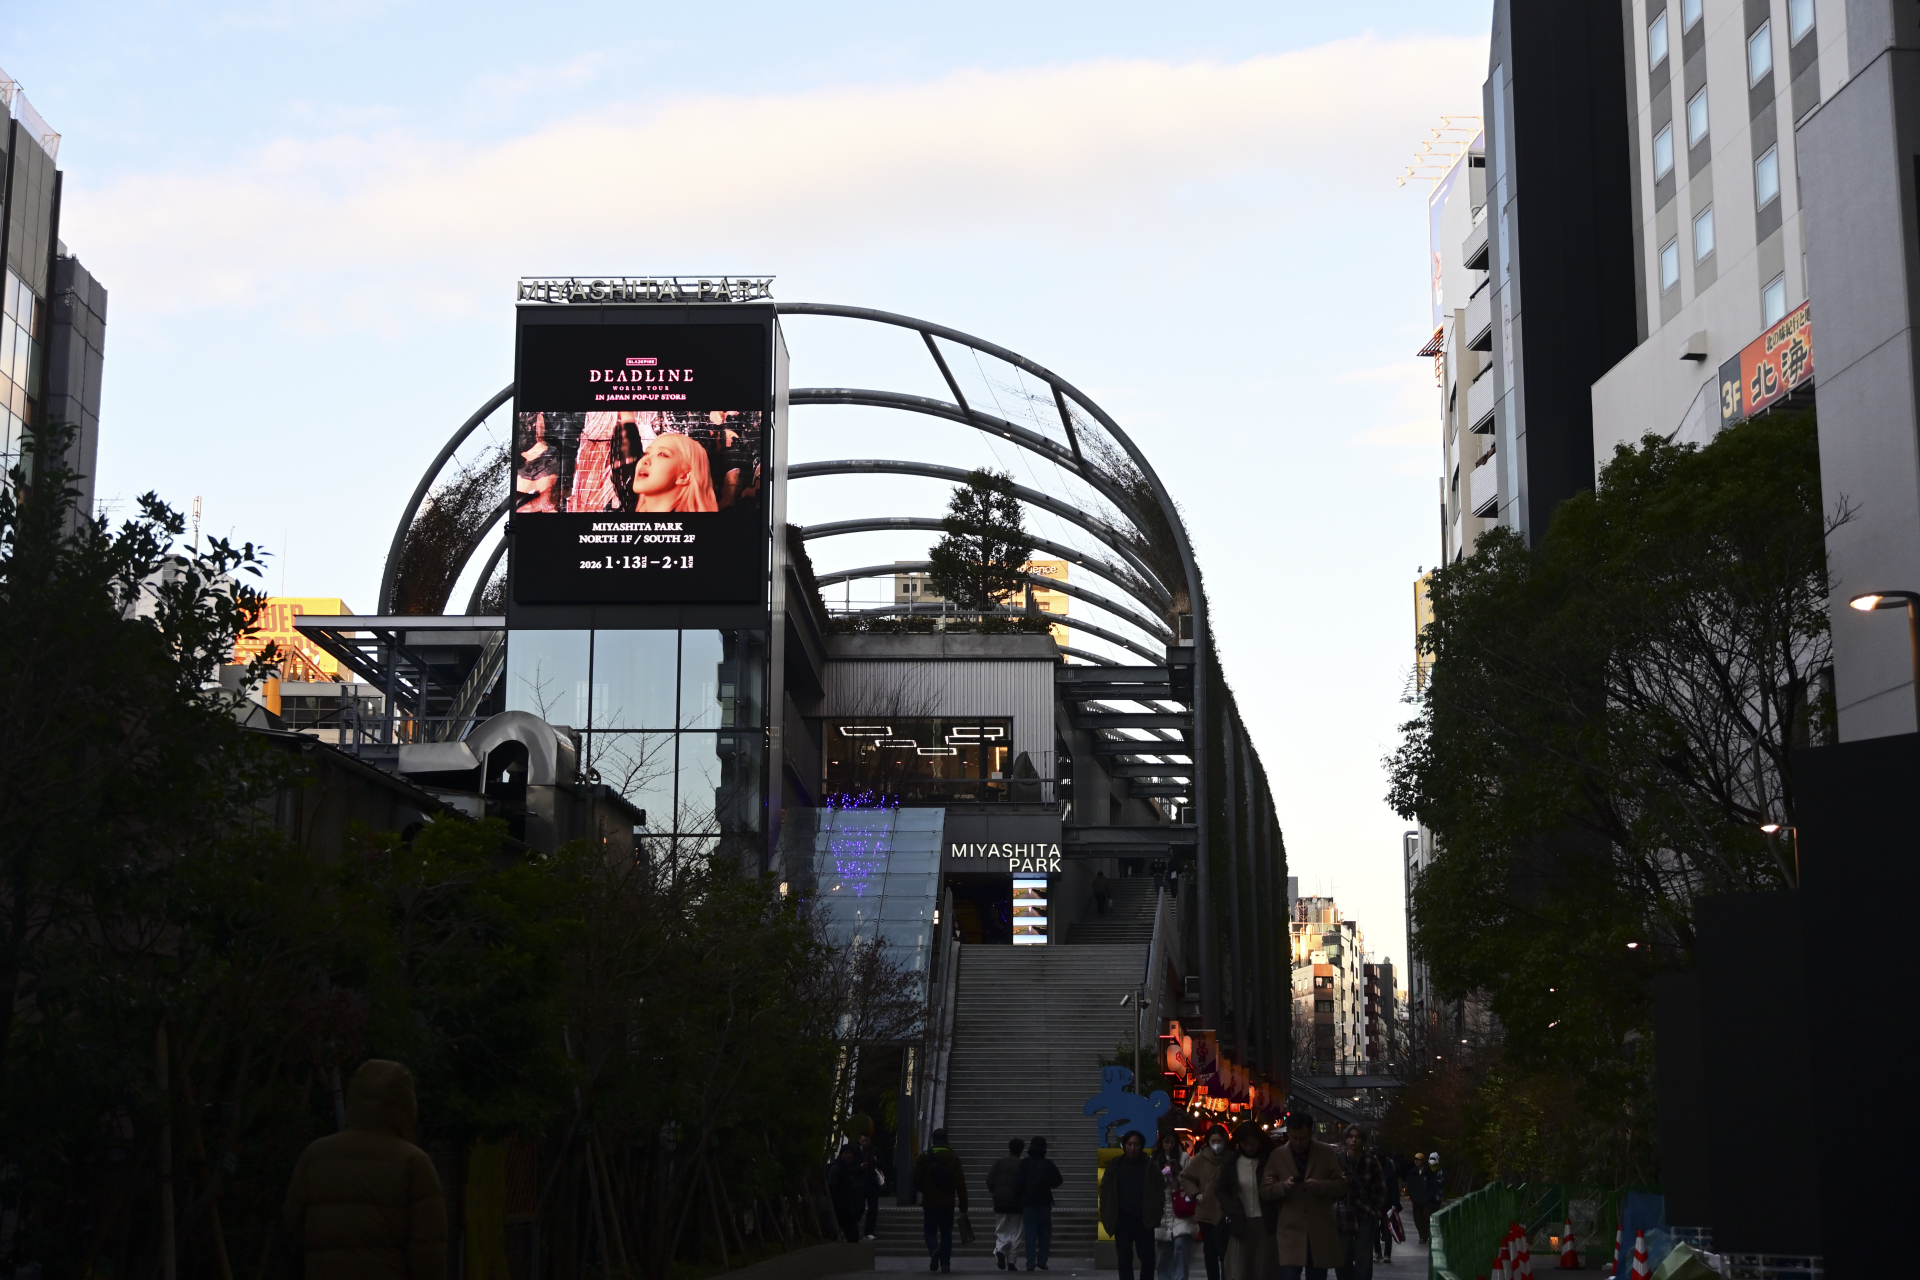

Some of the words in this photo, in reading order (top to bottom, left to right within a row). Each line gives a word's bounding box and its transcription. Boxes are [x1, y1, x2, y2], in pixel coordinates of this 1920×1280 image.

[517, 279, 676, 301] MIYASHITA
[697, 278, 774, 300] PARK
[589, 369, 694, 382] DEADLINE
[1751, 337, 1814, 406] 北海
[1722, 379, 1741, 419] 3F
[592, 522, 652, 531] MIYASHITA
[653, 522, 683, 531] PARK
[579, 534, 618, 544] NORTH
[621, 534, 633, 543] 1F
[643, 534, 681, 544] SOUTH
[683, 534, 696, 543] 2F
[579, 560, 602, 569] 2026
[951, 843, 1061, 858] MIYASHITA
[1009, 858, 1061, 872] PARK
